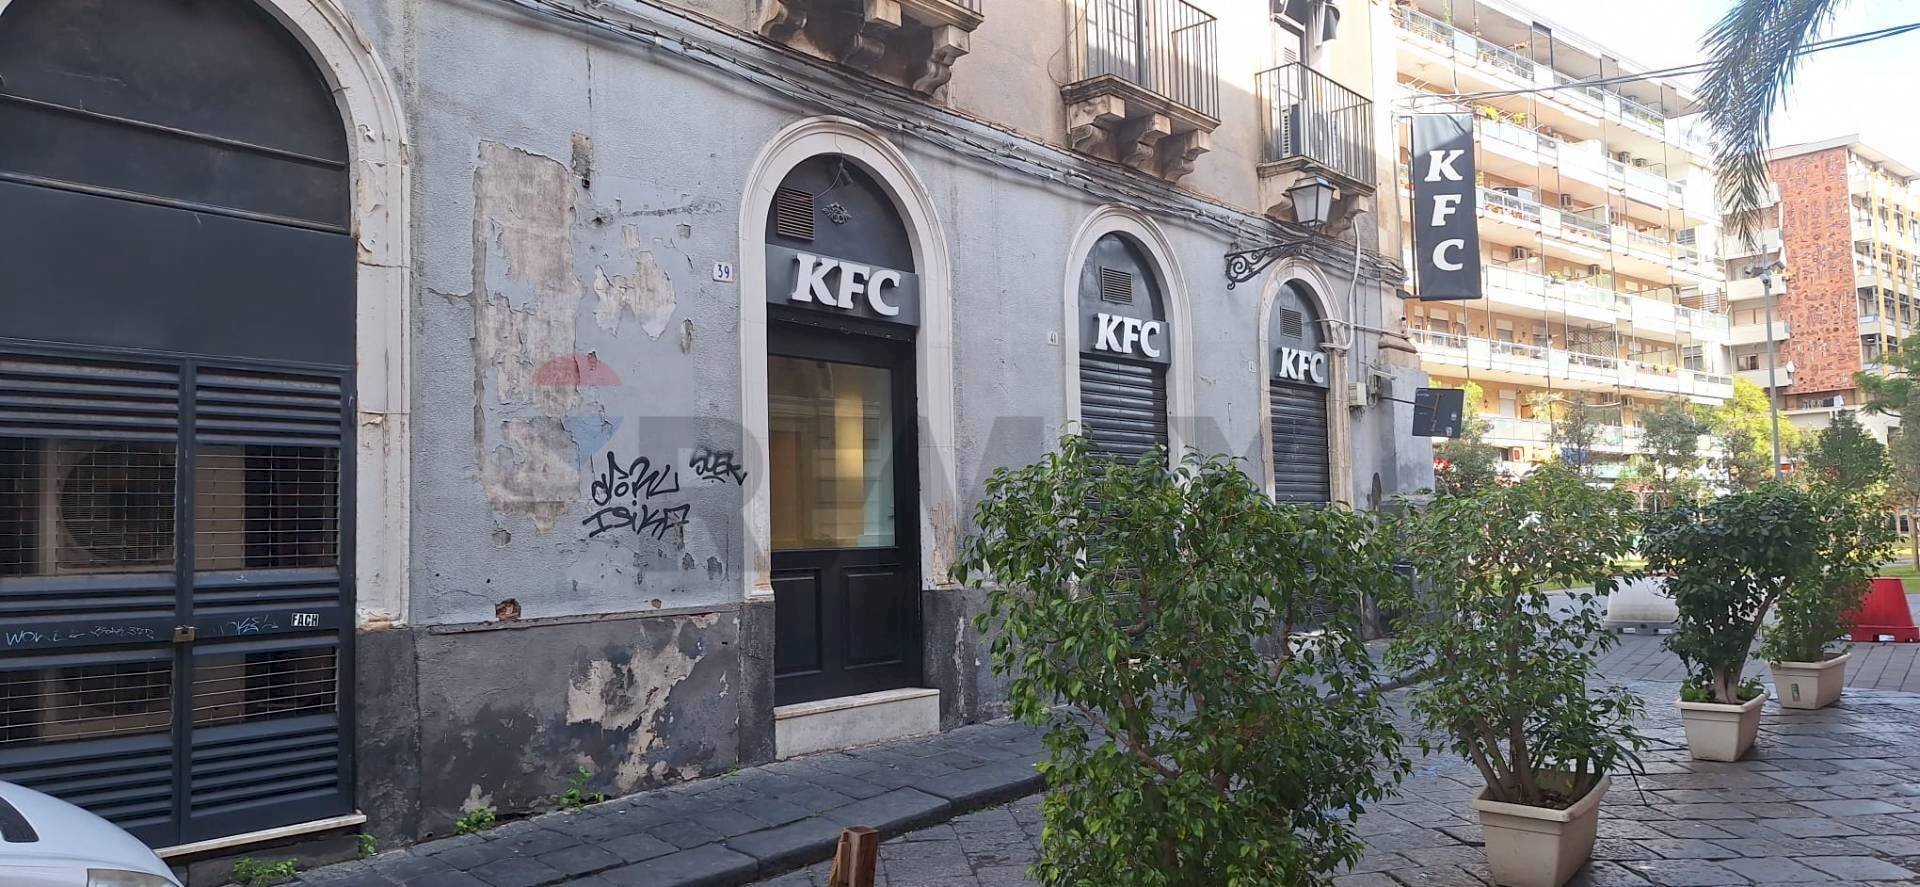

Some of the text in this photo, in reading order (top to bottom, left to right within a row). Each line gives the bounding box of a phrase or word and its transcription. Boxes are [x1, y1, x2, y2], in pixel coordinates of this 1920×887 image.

[1424, 150, 1464, 271] KFC
[717, 264, 730, 279] 39
[792, 253, 900, 316] KFC
[1095, 312, 1161, 358] KFC
[1279, 346, 1325, 383] KFC
[292, 613, 319, 627] FACH
